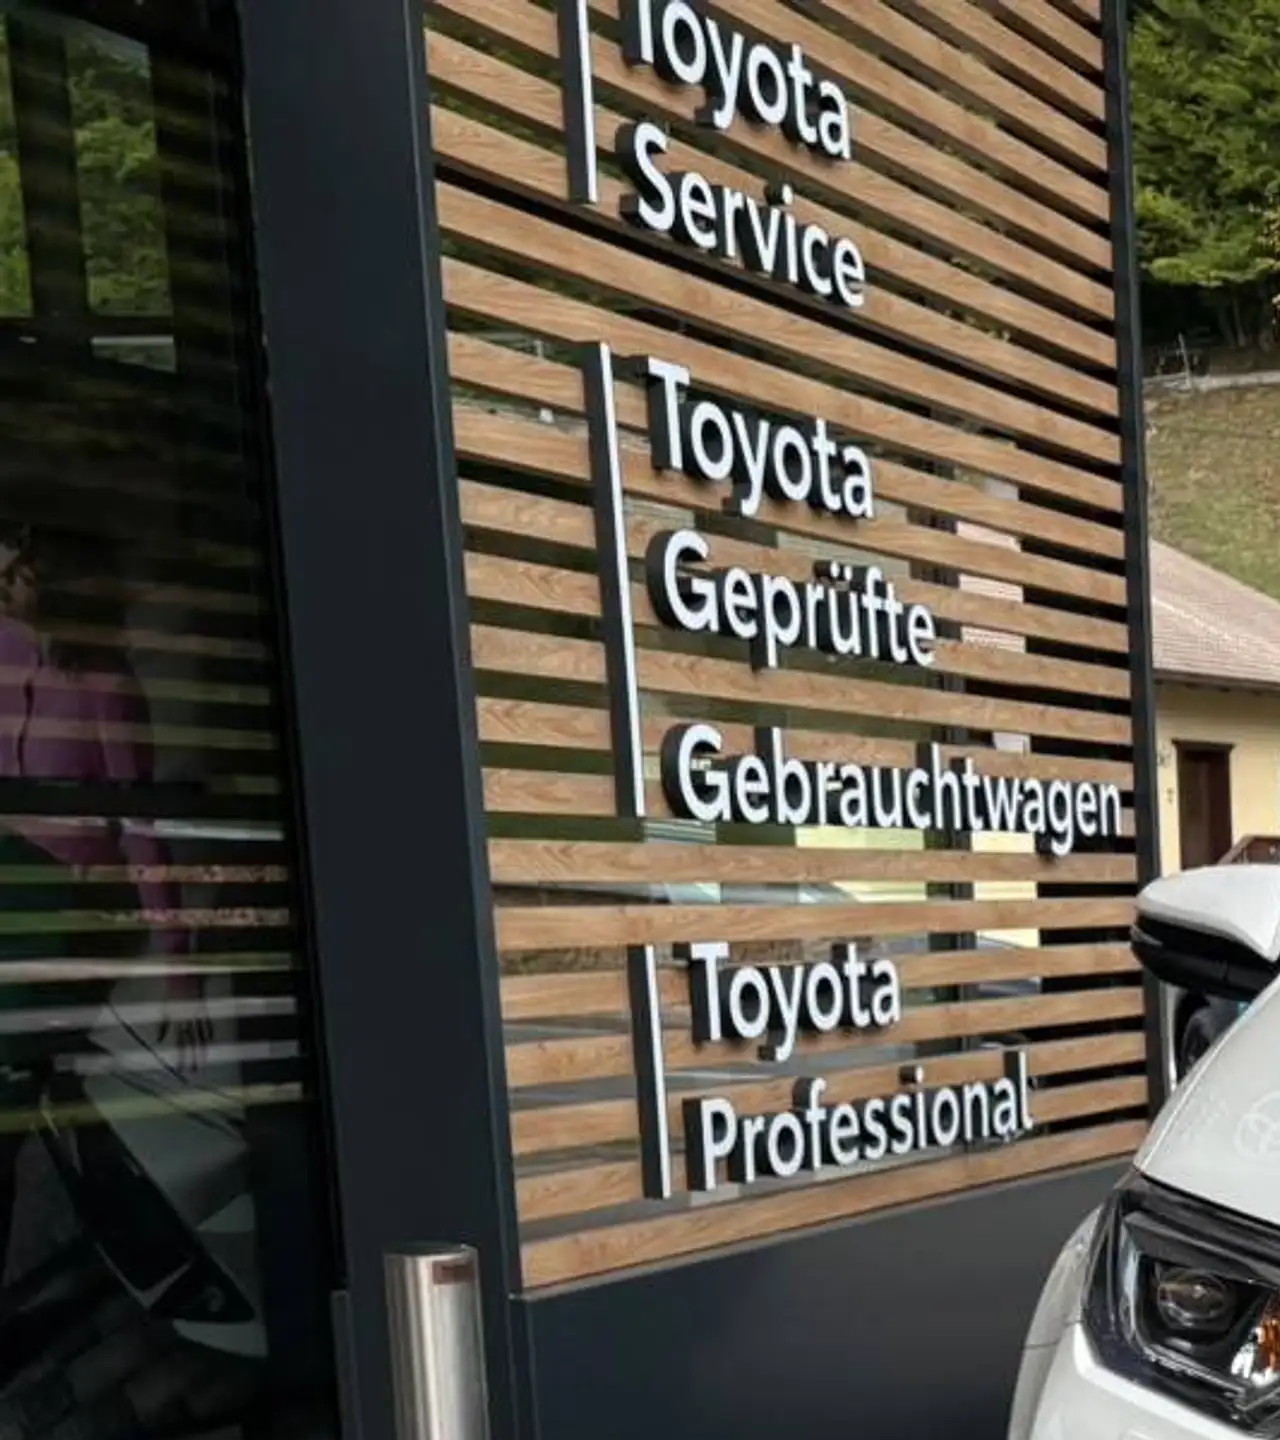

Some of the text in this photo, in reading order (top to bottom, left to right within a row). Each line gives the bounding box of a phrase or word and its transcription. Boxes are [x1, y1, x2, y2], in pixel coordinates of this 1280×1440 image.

[633, 121, 866, 307] Service
[646, 358, 874, 519] Toyota
[665, 530, 938, 668] Geprüfte
[677, 724, 1124, 854] Gebrauchtwagen
[691, 942, 901, 1060] Toyota
[701, 1051, 1034, 1190] Professional
